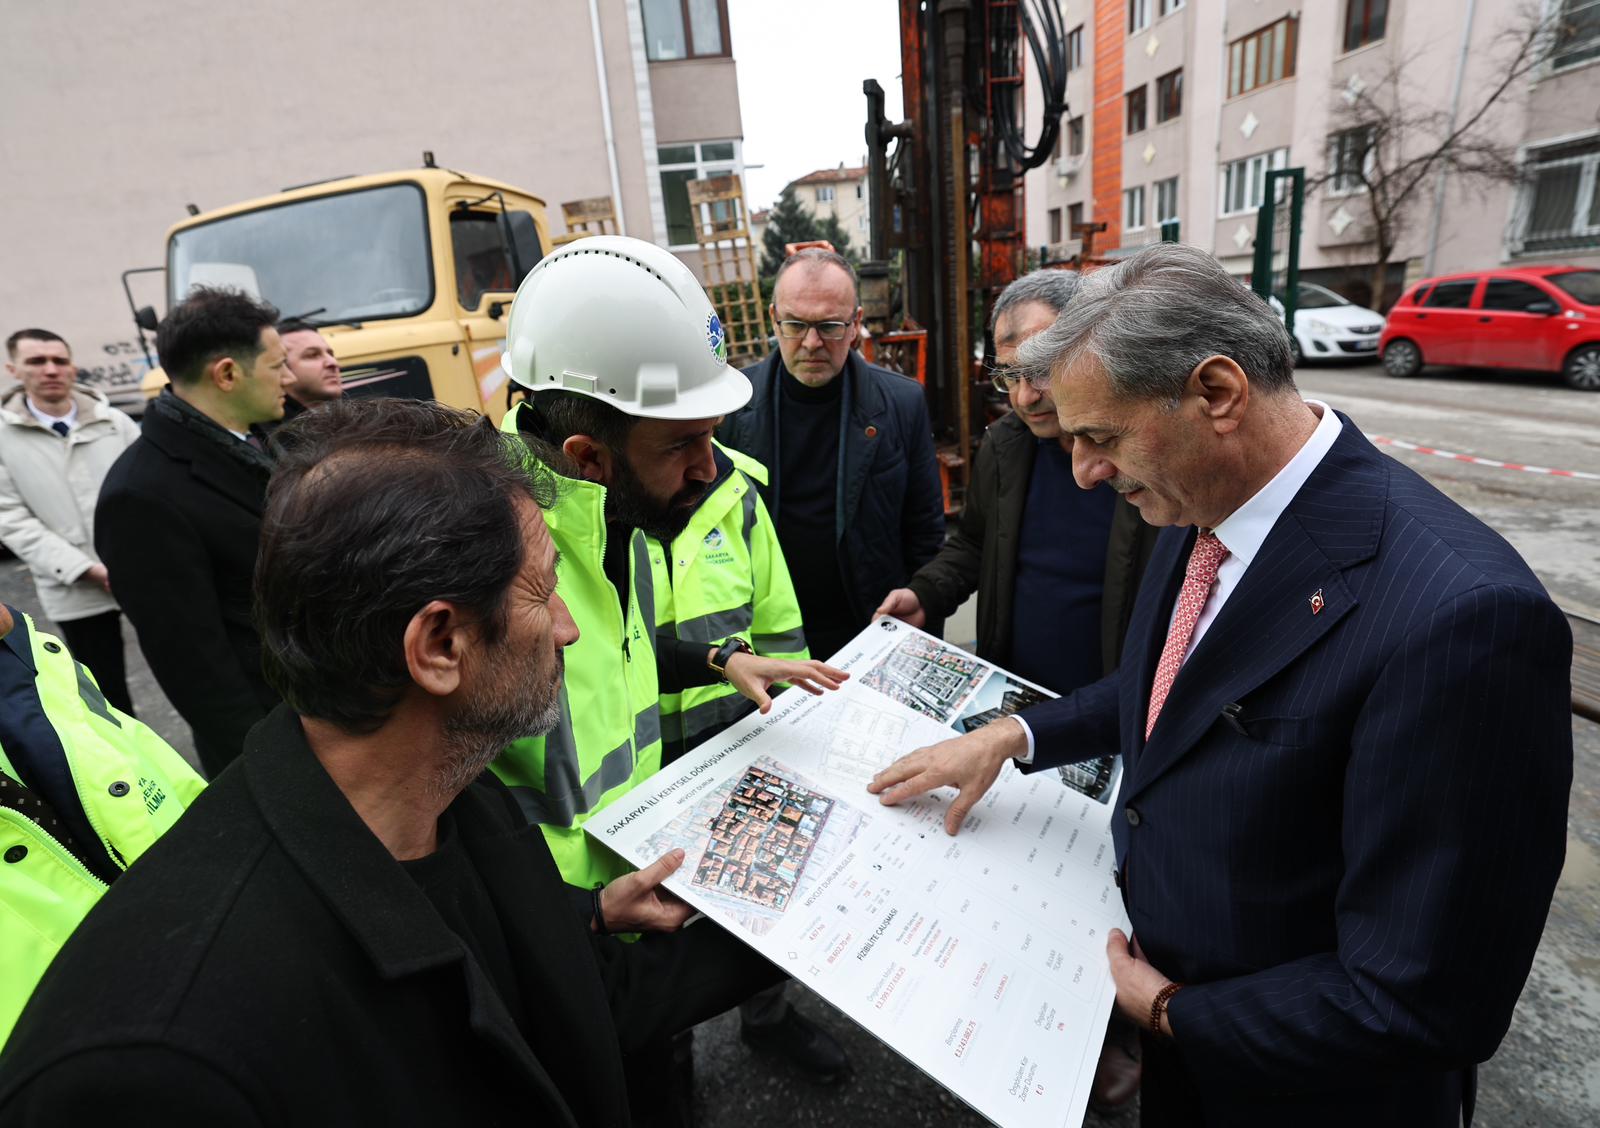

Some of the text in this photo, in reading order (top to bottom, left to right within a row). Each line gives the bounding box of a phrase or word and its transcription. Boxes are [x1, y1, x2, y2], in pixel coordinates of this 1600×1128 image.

[606, 805, 648, 836] SAKARYA
[648, 794, 659, 808] İLİ
[658, 775, 694, 799] KENTSEL
[690, 752, 726, 777] DÖNÜŞÜM
[724, 727, 765, 755] FAALİYETLERİ
[676, 777, 715, 805] MEVCUT DURUM
[857, 908, 898, 962] FİZİBİLİTE ÇALIŞMASI
